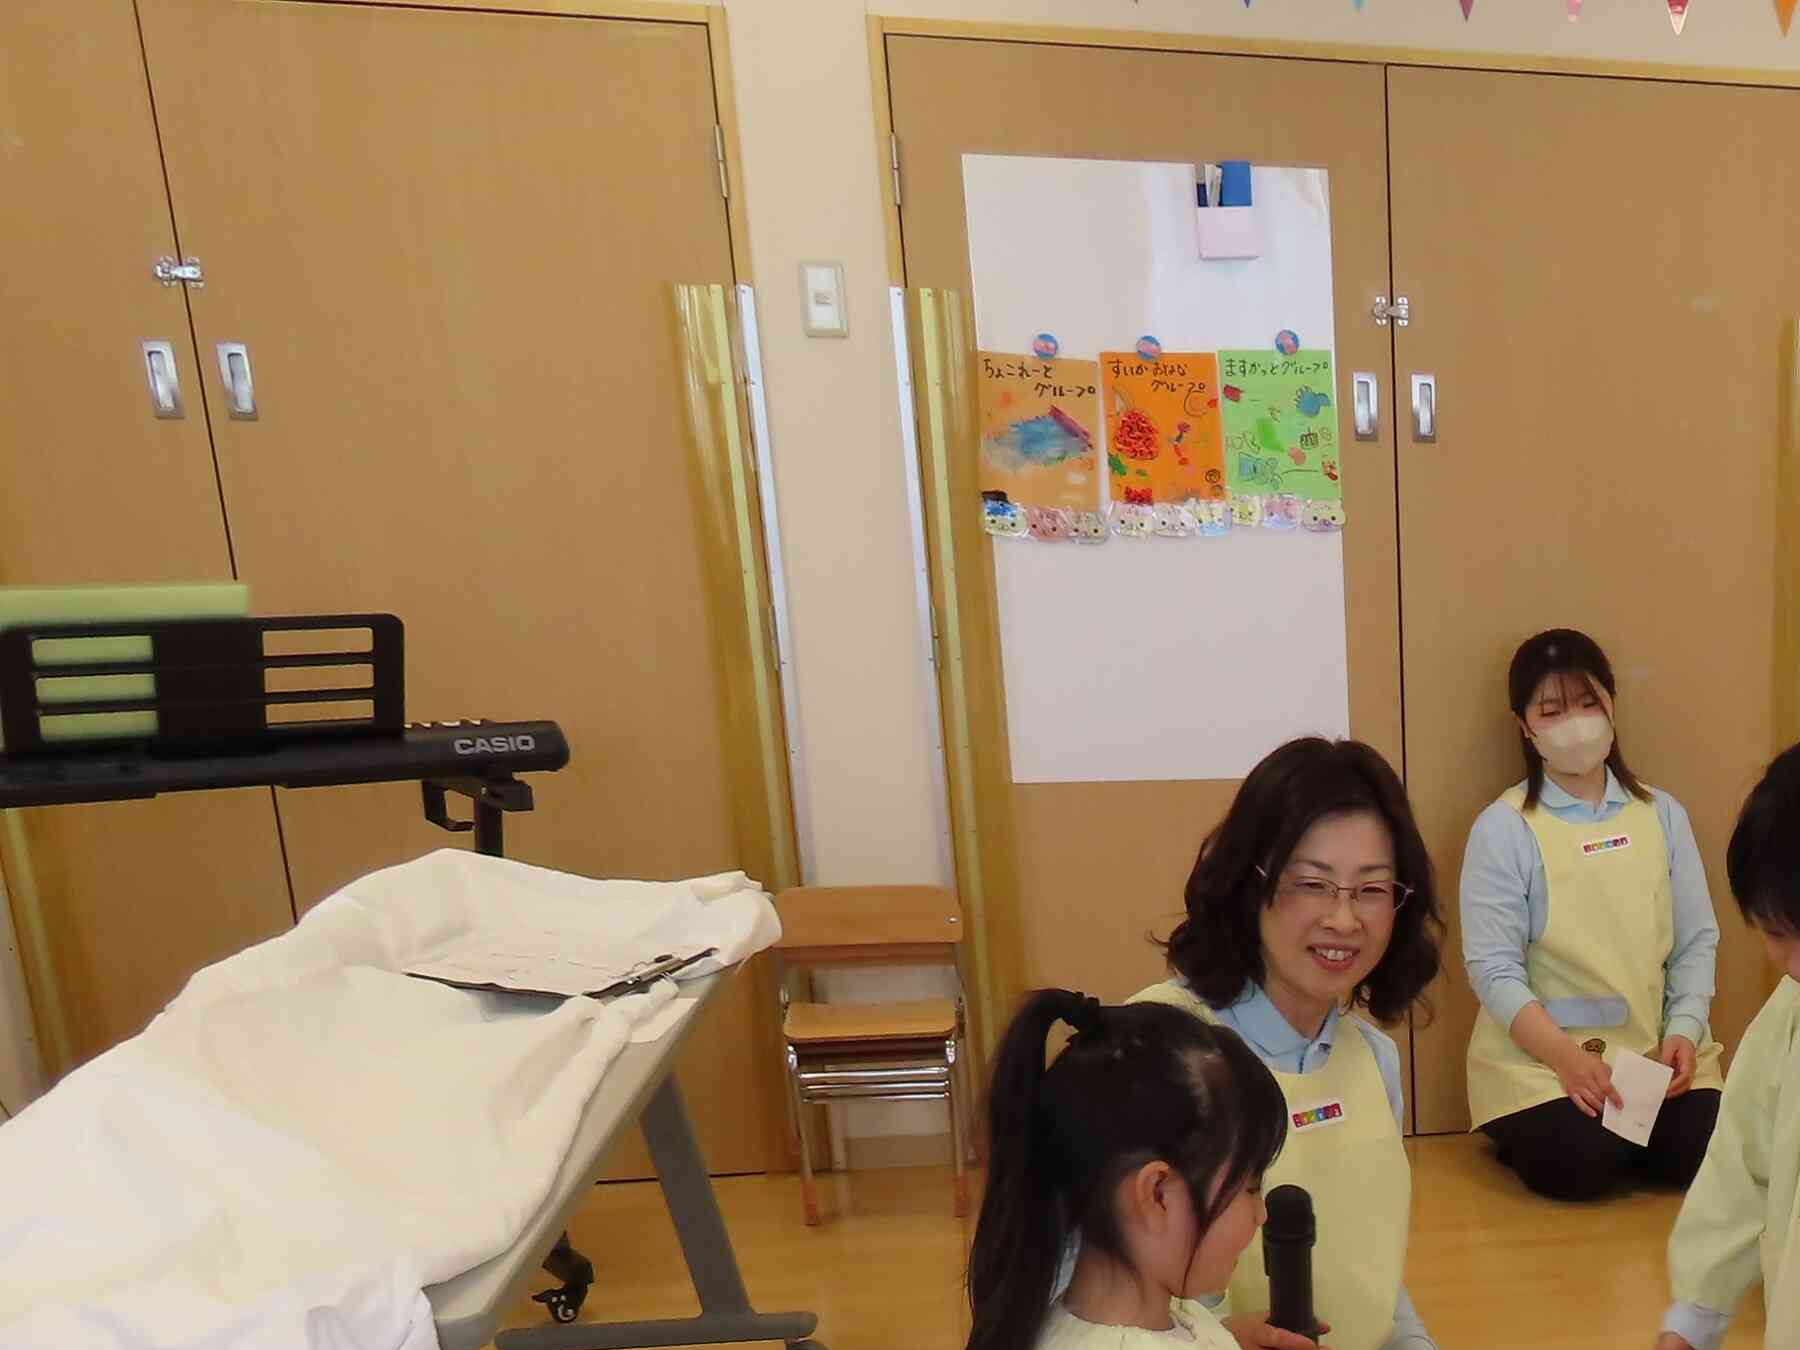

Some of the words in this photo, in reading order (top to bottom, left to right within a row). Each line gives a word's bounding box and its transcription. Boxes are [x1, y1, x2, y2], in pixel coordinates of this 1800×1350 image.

[1034, 382, 1097, 399] グループ
[453, 734, 536, 755] CASIO
